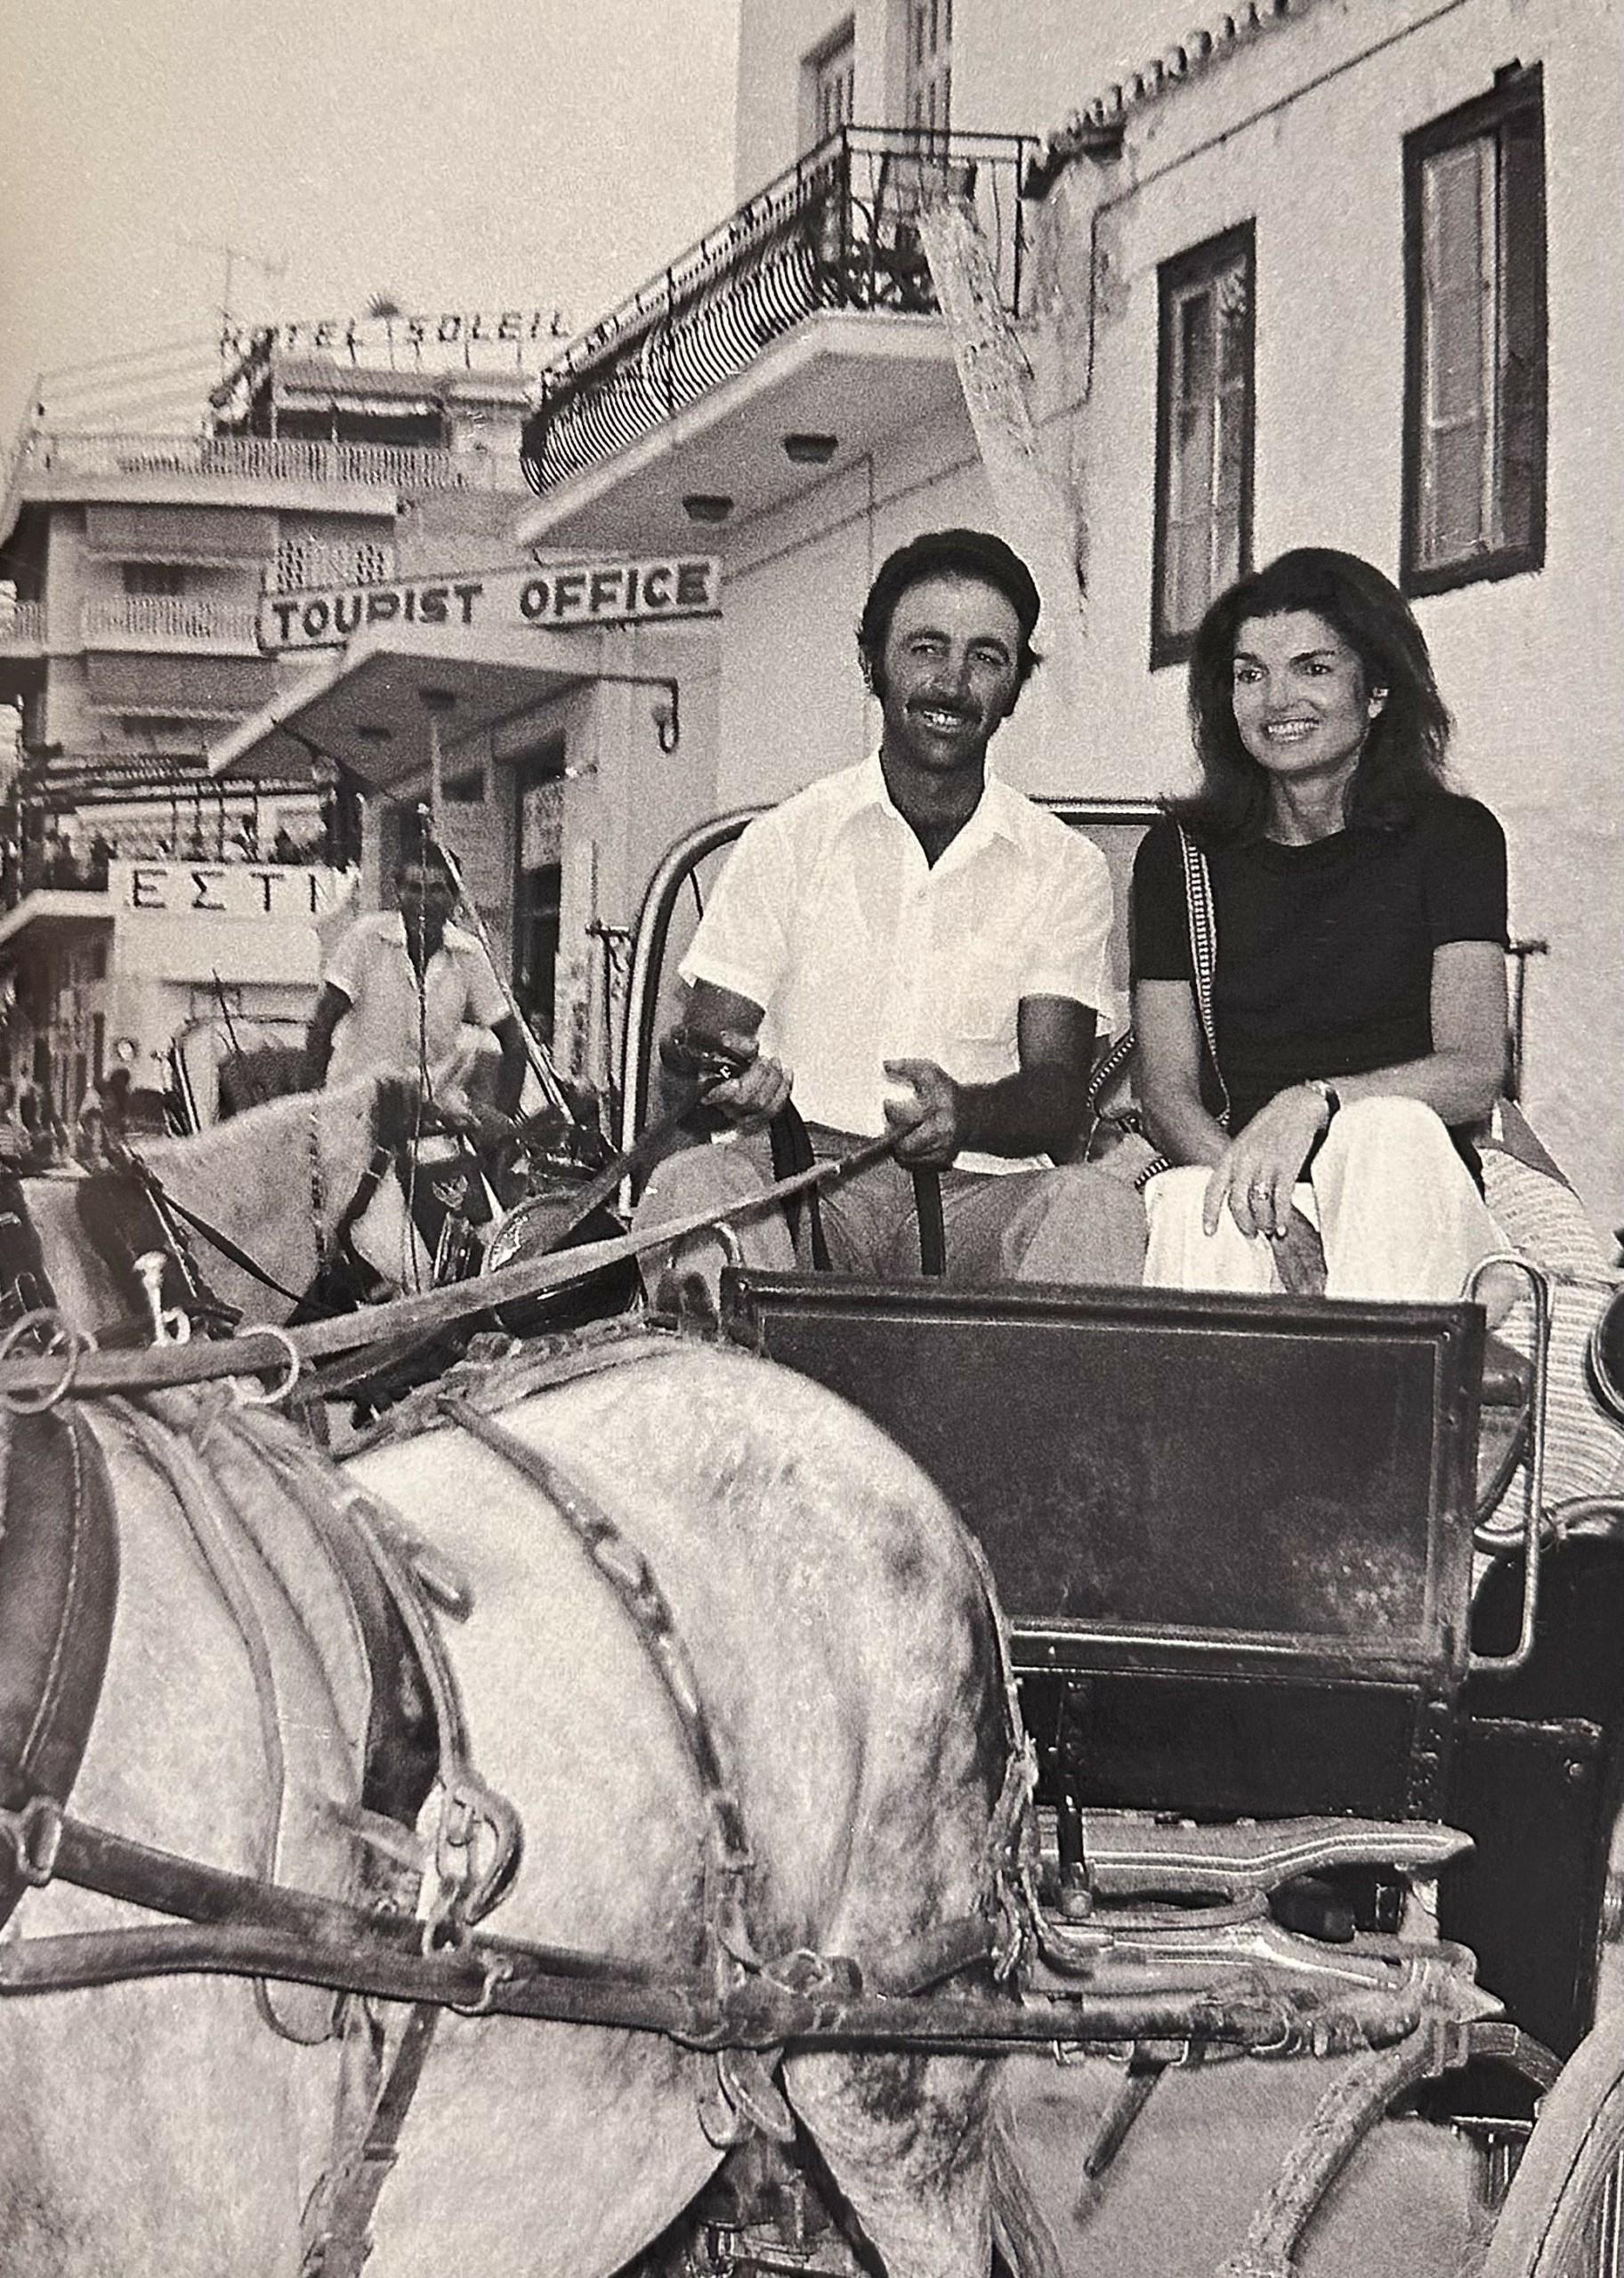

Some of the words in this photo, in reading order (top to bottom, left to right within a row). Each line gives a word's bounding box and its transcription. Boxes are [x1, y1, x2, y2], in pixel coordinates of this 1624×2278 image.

[407, 311, 569, 343] SOLEIL
[271, 583, 483, 640] TOURIST
[520, 562, 711, 620] OFFICE
